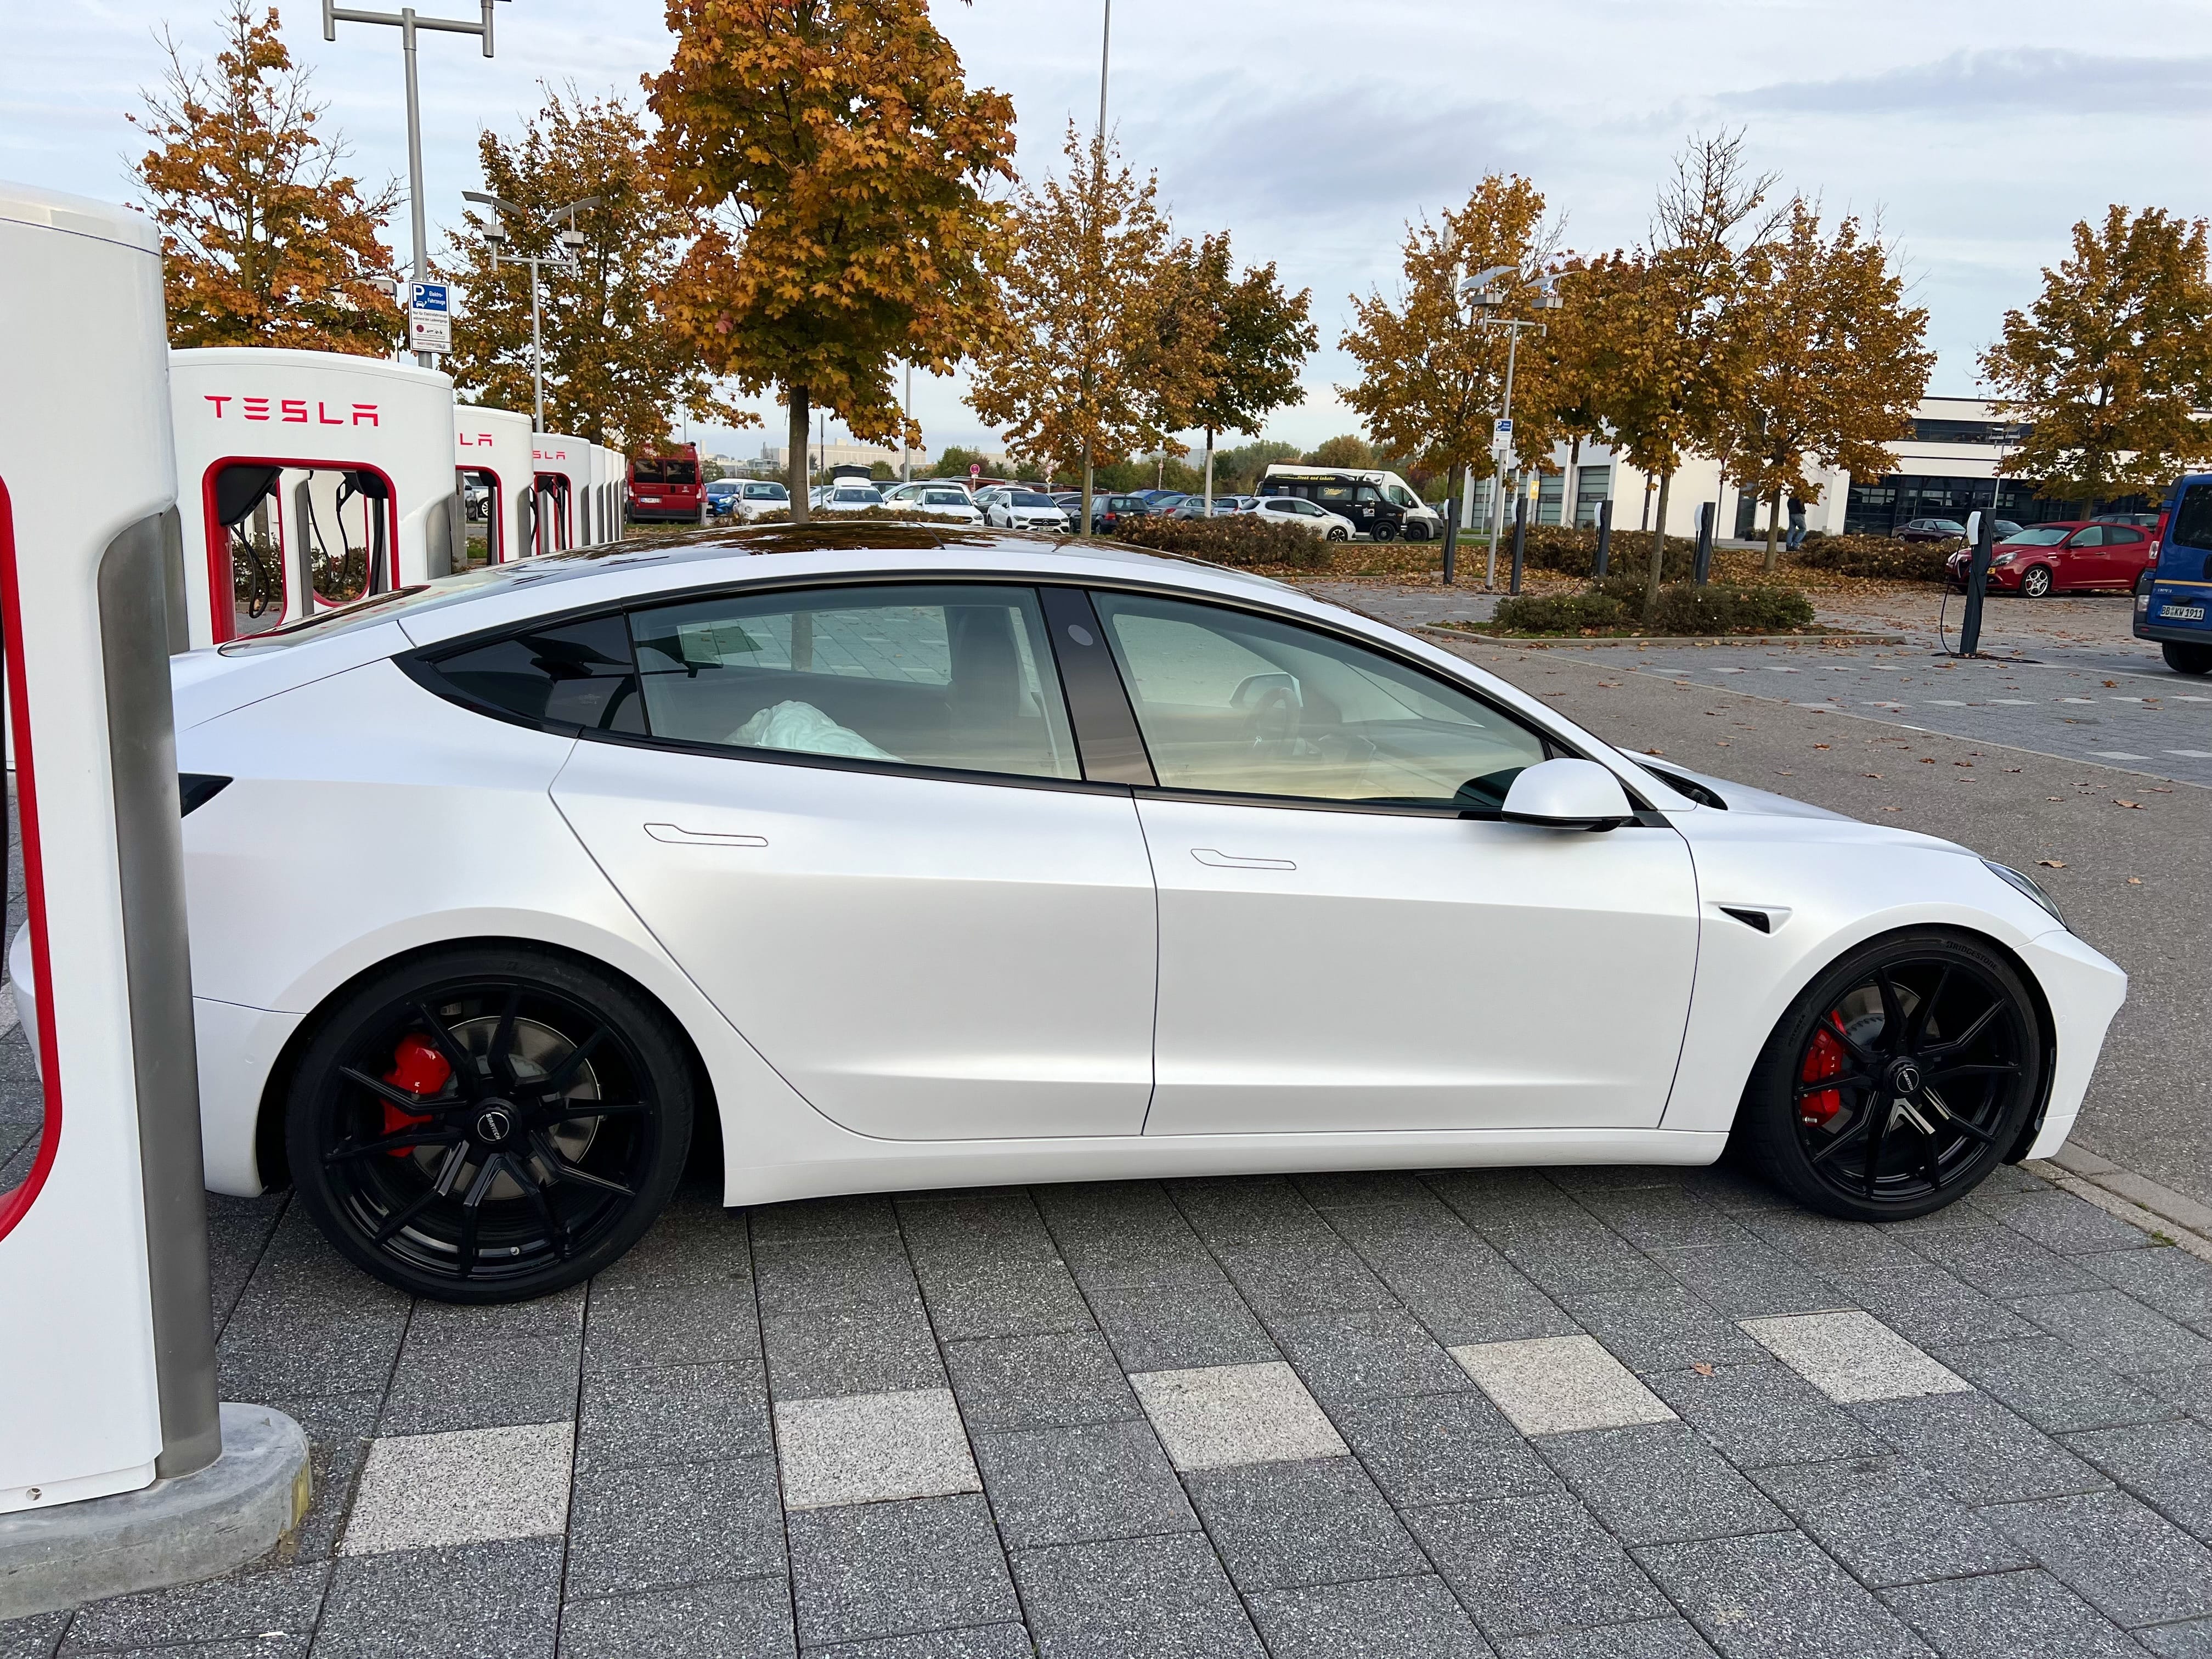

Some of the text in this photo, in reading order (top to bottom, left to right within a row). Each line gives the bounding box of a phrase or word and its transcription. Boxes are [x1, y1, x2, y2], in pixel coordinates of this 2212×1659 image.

[413, 284, 425, 302] P
[204, 396, 379, 426] TESLA
[533, 450, 566, 460] SLA
[2162, 607, 2203, 618] BB KW 1911
[1945, 941, 1997, 970] BRIDGESTONE
[486, 1114, 501, 1139] STARTECH
